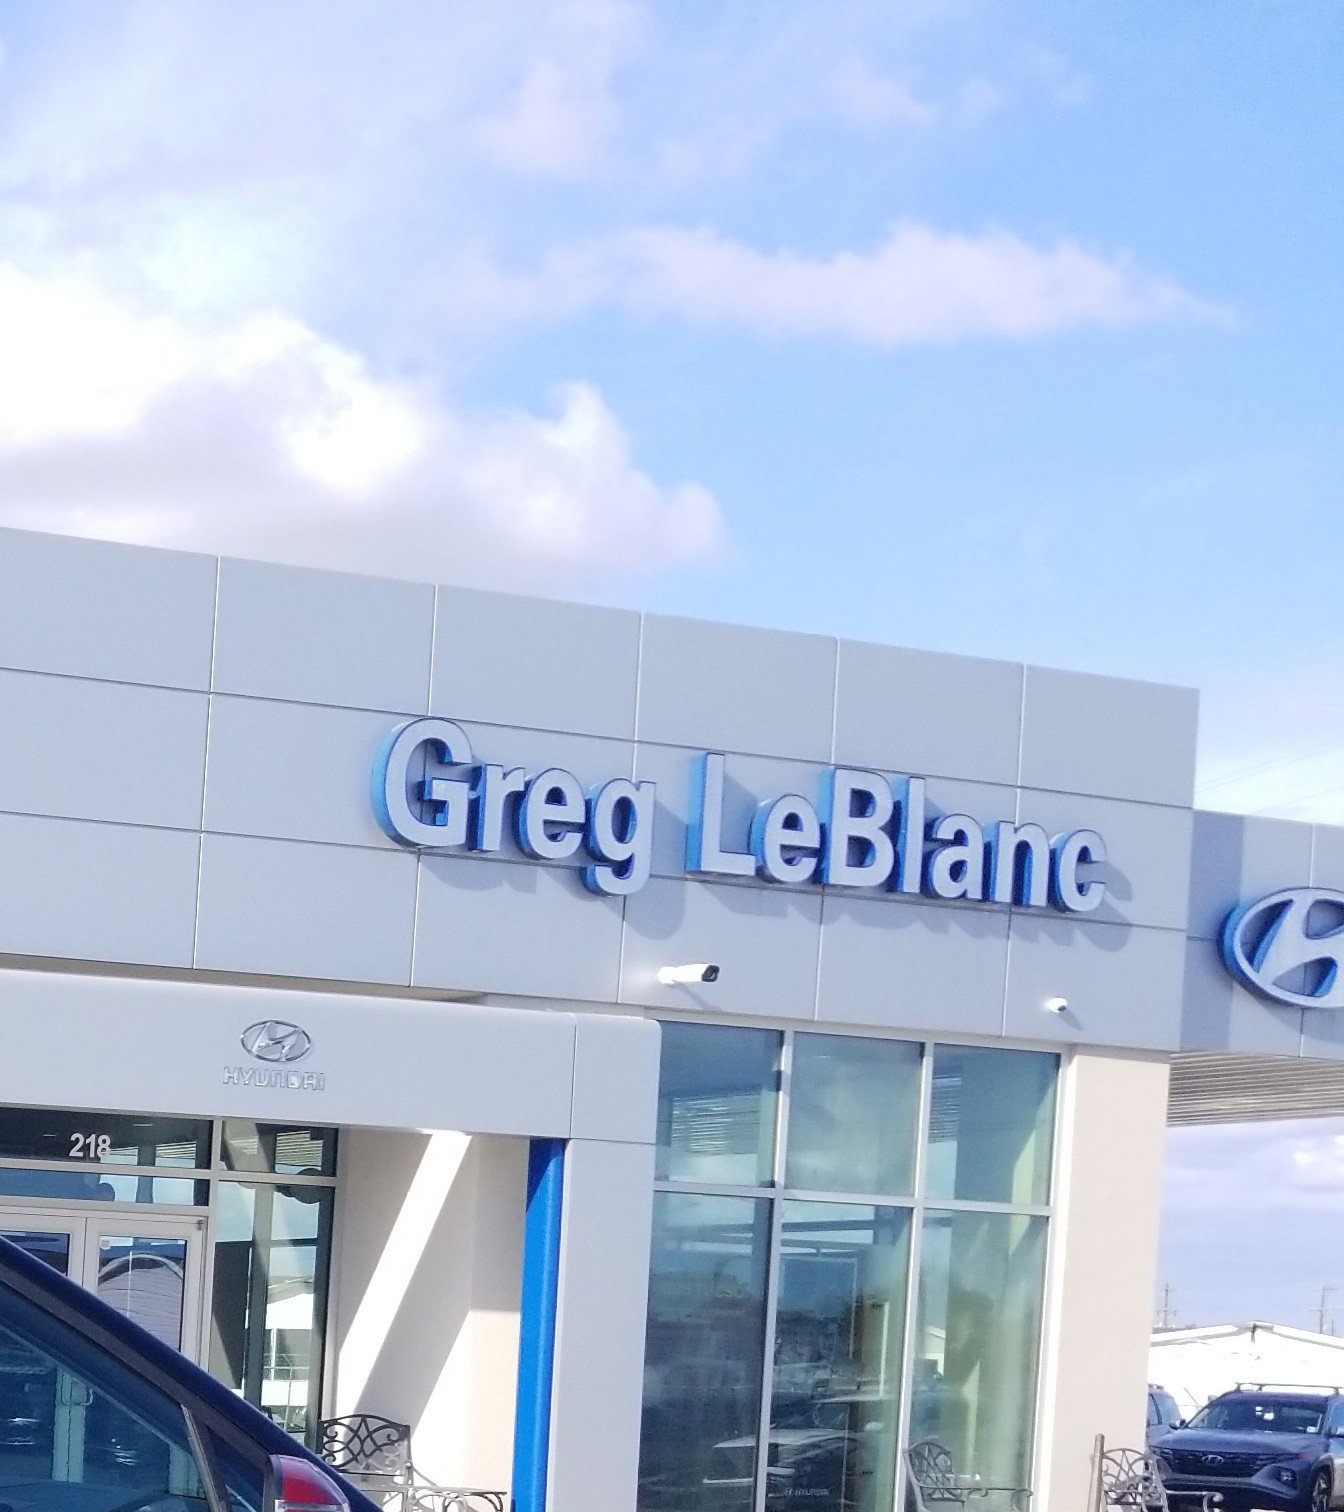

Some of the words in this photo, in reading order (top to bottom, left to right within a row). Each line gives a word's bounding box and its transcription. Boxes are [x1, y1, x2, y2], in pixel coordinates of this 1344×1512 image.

[371, 717, 658, 896] Greg
[686, 751, 1108, 913] LeBlanc
[223, 1067, 326, 1091] HYUNDAI
[69, 1132, 112, 1159] 218
